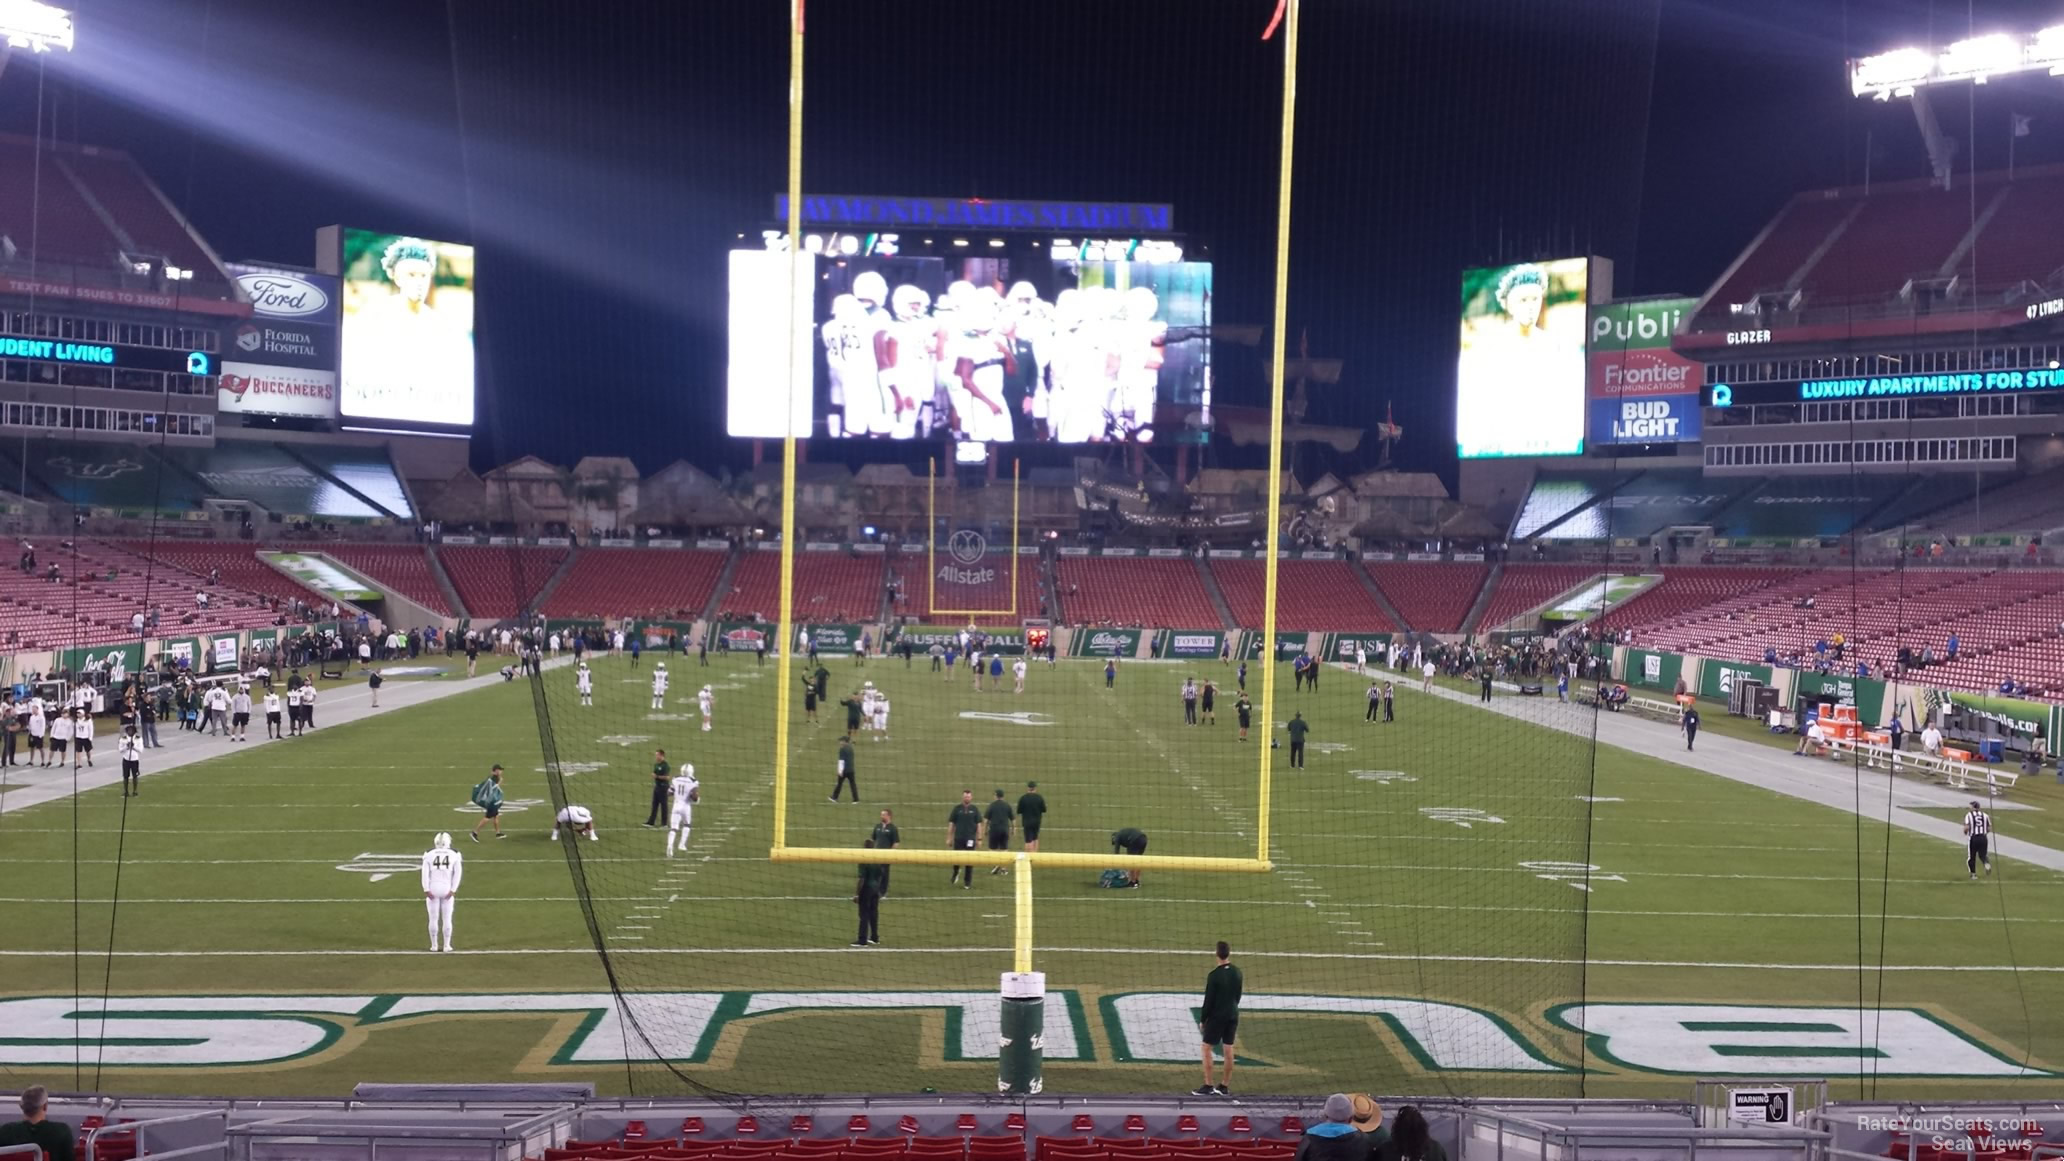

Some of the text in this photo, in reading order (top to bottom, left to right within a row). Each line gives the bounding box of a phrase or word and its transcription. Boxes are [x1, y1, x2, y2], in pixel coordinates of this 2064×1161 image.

[936, 201, 1036, 227] JAMES
[1040, 203, 1169, 230] STADIUM
[252, 279, 307, 309] Ford
[1593, 309, 1681, 342] Publi
[264, 328, 311, 344] FLORIDA
[1727, 330, 1771, 344] GLAZER
[55, 343, 113, 363] LIVING
[264, 341, 316, 356] HOSPITAL
[1605, 362, 1691, 385] Frontier
[252, 377, 333, 400] BUCCANEERS
[1802, 379, 1867, 398] LUXURY
[1868, 374, 1982, 396] APARTMENTS
[1986, 371, 2023, 390] FOR
[1622, 401, 1670, 420] BUD
[1613, 418, 1679, 438] LIGHT
[937, 564, 995, 585] Allstate
[1175, 637, 1214, 646] TOWER
[1647, 658, 1659, 672] USF
[677, 784, 685, 796] 11
[433, 855, 450, 870] 44
[1737, 1095, 1769, 1104] WARNING
